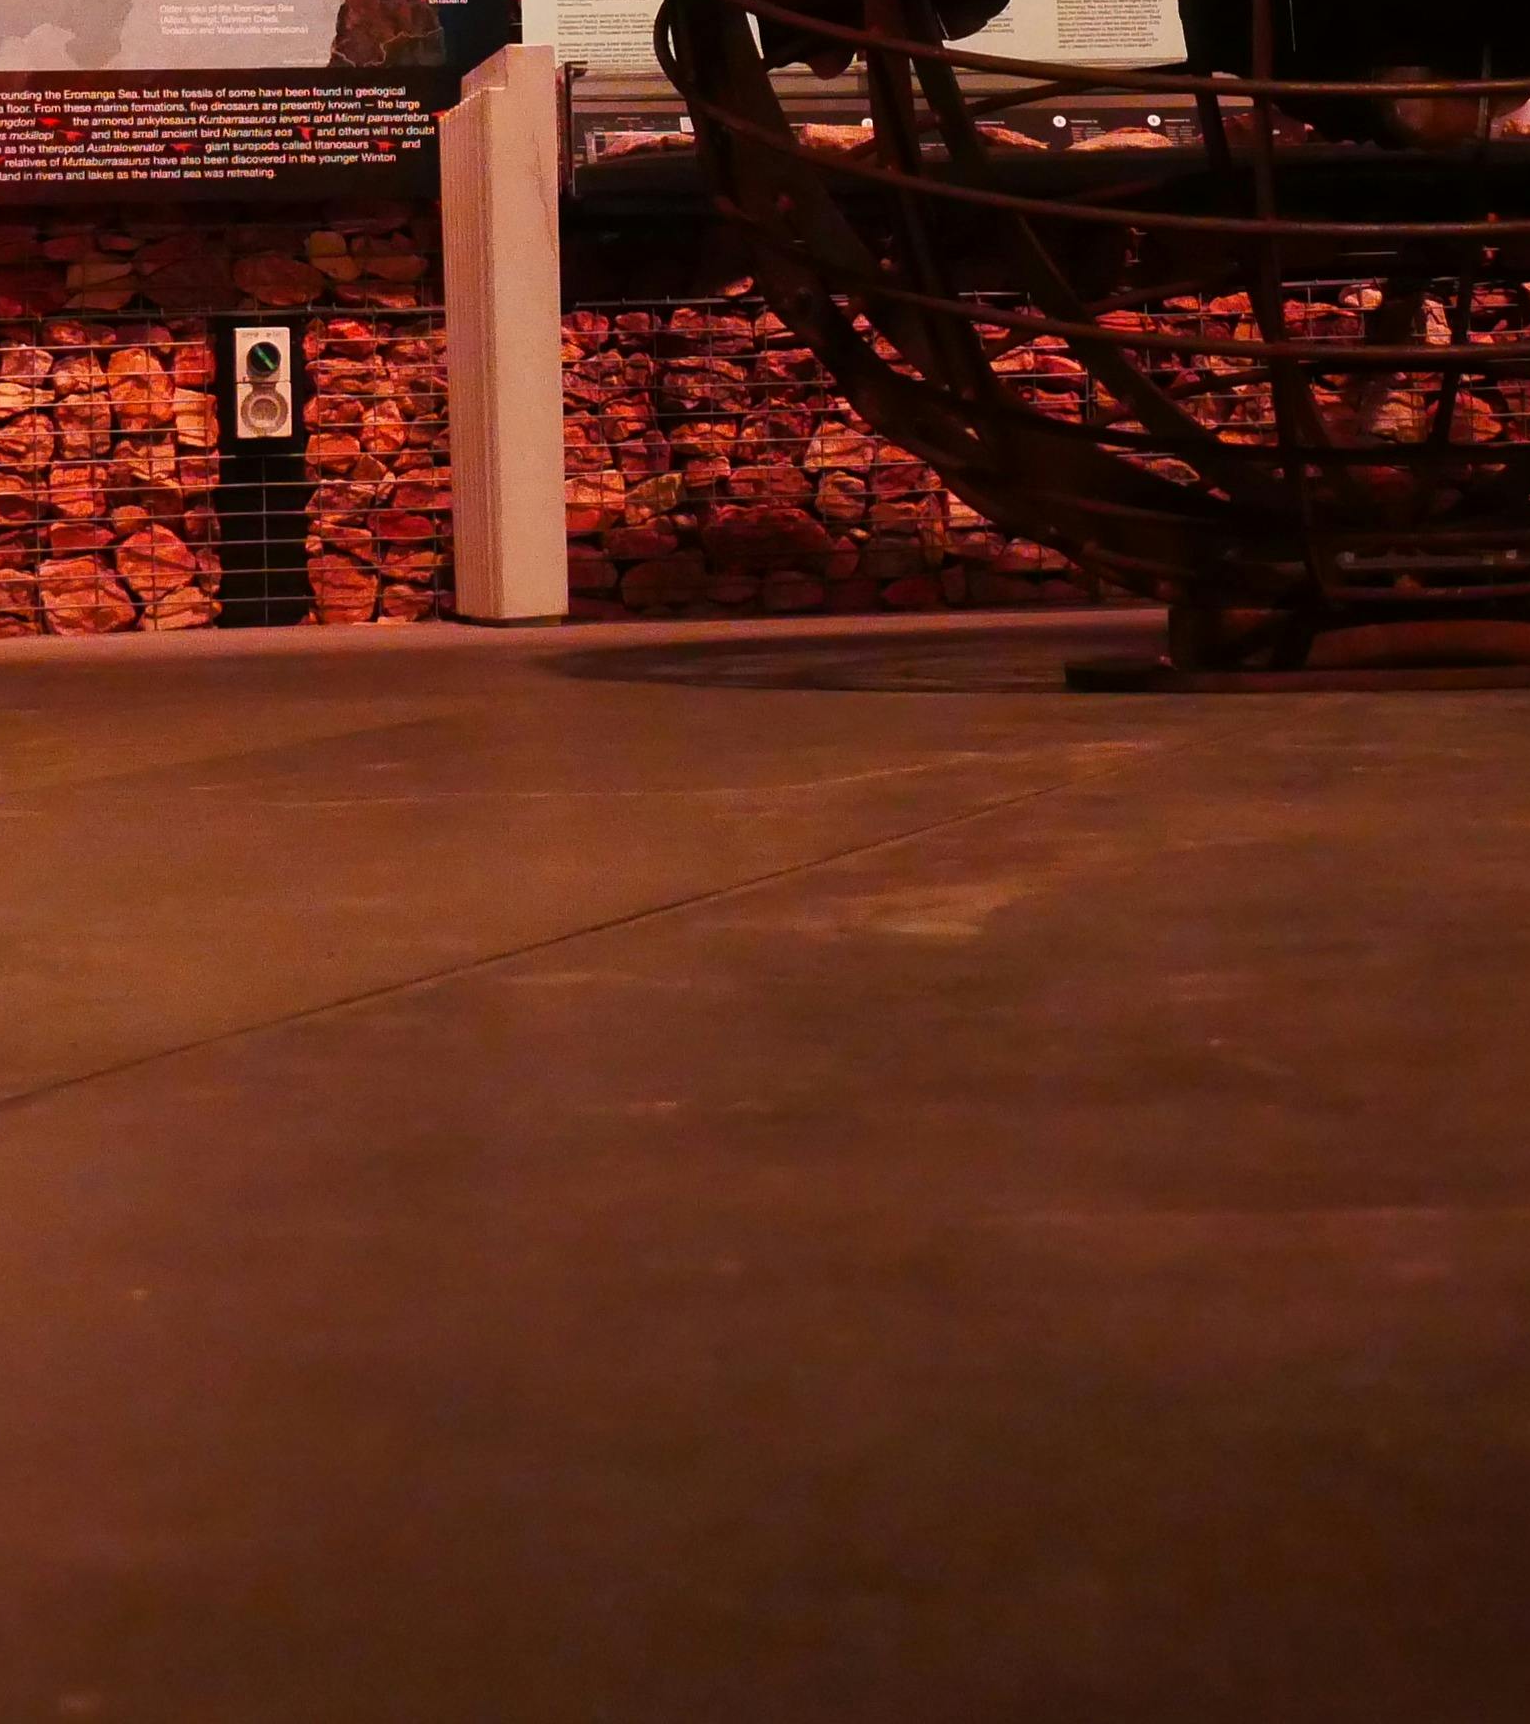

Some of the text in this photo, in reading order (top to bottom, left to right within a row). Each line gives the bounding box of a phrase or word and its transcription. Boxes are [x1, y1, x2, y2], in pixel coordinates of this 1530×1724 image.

[45, 90, 61, 100] the
[64, 89, 115, 102] Eromanga
[143, 89, 160, 99] but
[163, 88, 179, 98] the
[181, 88, 213, 99] fossils
[215, 87, 226, 98] of
[229, 89, 256, 98] some
[259, 87, 282, 97] have
[285, 87, 310, 98] been
[313, 87, 341, 97] found
[344, 88, 353, 96] in
[355, 87, 405, 99] geological
